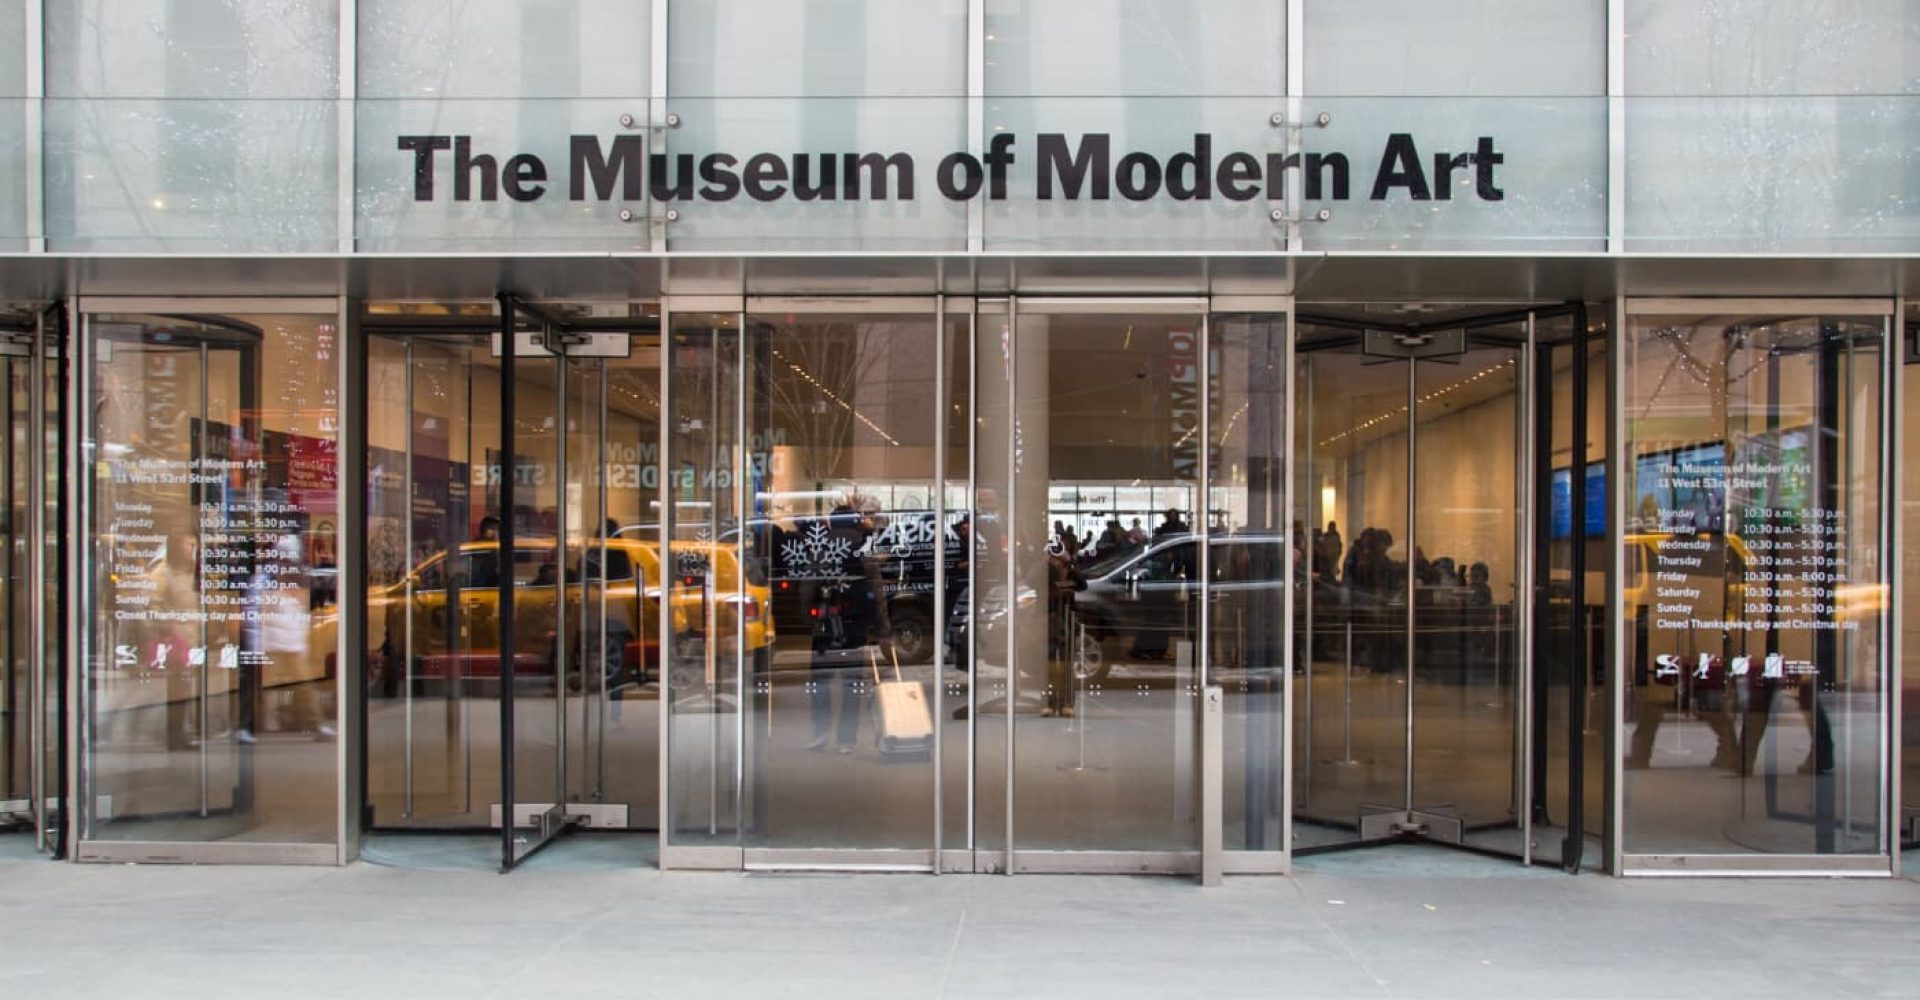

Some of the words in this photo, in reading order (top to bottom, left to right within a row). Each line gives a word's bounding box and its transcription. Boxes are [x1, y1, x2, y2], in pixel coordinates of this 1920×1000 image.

[397, 133, 547, 203] The
[567, 133, 914, 203] Museum
[936, 133, 1015, 203] of
[1036, 133, 1350, 203] Modern
[1370, 133, 1505, 203] Art
[189, 460, 200, 469] of
[203, 460, 243, 469] Modern
[247, 460, 264, 469] Art
[1659, 463, 1679, 473] The
[1681, 463, 1731, 473] Museum
[1732, 463, 1743, 473] of
[1747, 463, 1787, 473] Modern
[1792, 463, 1810, 473] Art
[130, 473, 160, 483] West
[189, 473, 223, 483] Street
[1672, 478, 1700, 488] West
[1704, 478, 1730, 488] 53rd
[1732, 478, 1768, 488] Street
[1657, 508, 1694, 519] Monday
[1744, 508, 1772, 519] 10:30
[279, 518, 299, 528] p.m.
[1657, 525, 1696, 535] Tuesday
[1744, 525, 1772, 535] 10:30
[1657, 540, 1710, 551] Wednesday
[1744, 540, 1772, 551] 10:30
[1657, 556, 1701, 567] Thursday
[1744, 556, 1772, 567] 10:30
[1657, 572, 1687, 583] Friday
[1744, 572, 1772, 583] 10:30
[1657, 588, 1700, 598] Saturday
[1744, 588, 1772, 598] 10:30
[1657, 604, 1692, 614] Sunday
[1744, 604, 1772, 614] 10:30
[115, 612, 146, 621] Closed
[149, 612, 207, 621] Thanksgiving
[210, 612, 227, 621] day
[229, 612, 244, 621] and
[1657, 619, 1689, 631] Closed
[1692, 619, 1752, 631] Thanksgiving
[1754, 619, 1770, 631] day
[1773, 619, 1790, 631] and
[1792, 619, 1840, 631] Christmas
